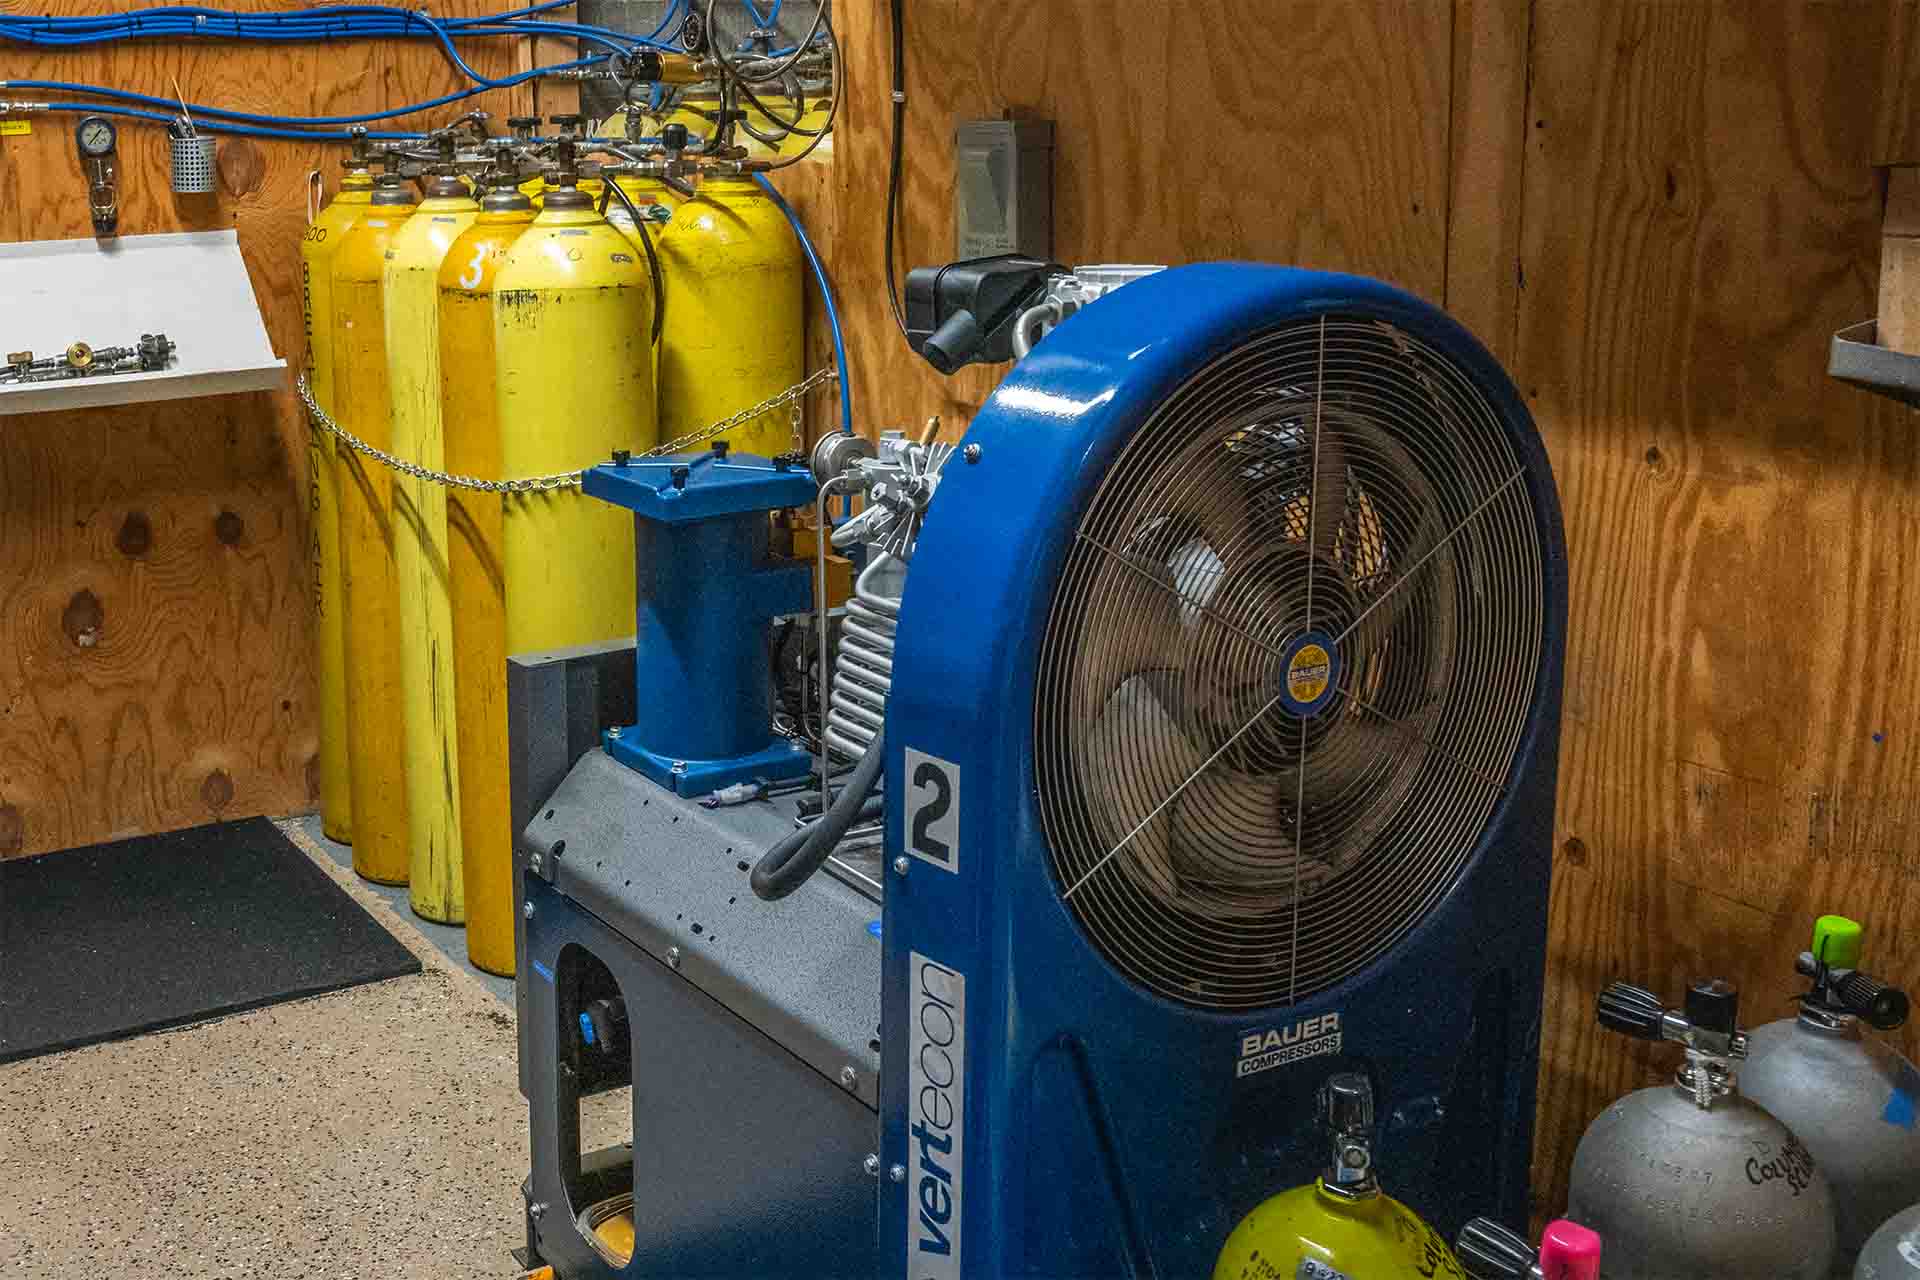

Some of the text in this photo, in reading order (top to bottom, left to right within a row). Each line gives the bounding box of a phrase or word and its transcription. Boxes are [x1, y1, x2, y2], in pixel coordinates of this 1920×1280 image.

[459, 241, 487, 289] 3
[912, 762, 952, 863] 2
[1240, 1035, 1339, 1074] COMPRESSORS
[1241, 1012, 1339, 1057] BAUER
[911, 962, 955, 1257] vertecon
